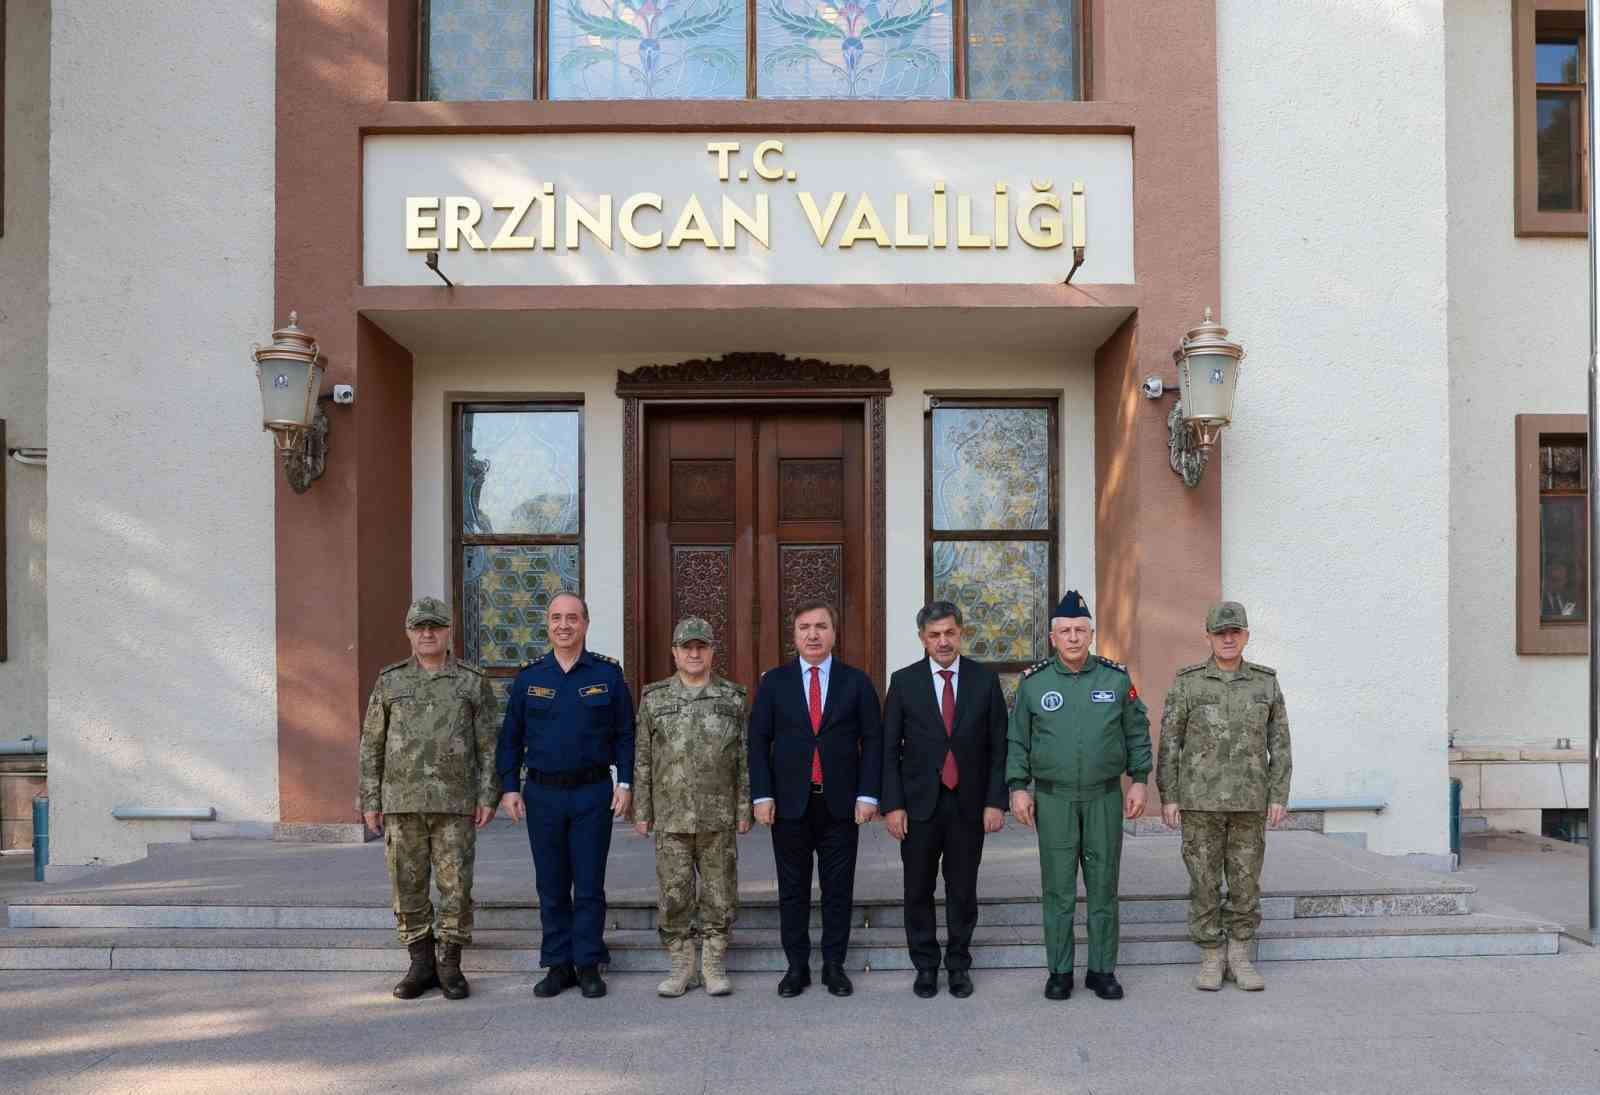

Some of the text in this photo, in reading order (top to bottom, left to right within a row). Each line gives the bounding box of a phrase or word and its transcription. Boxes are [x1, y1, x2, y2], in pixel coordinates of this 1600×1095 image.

[707, 140, 796, 181] T.C.
[406, 179, 1086, 250] ERZİNCAN VALİLİĞİ
